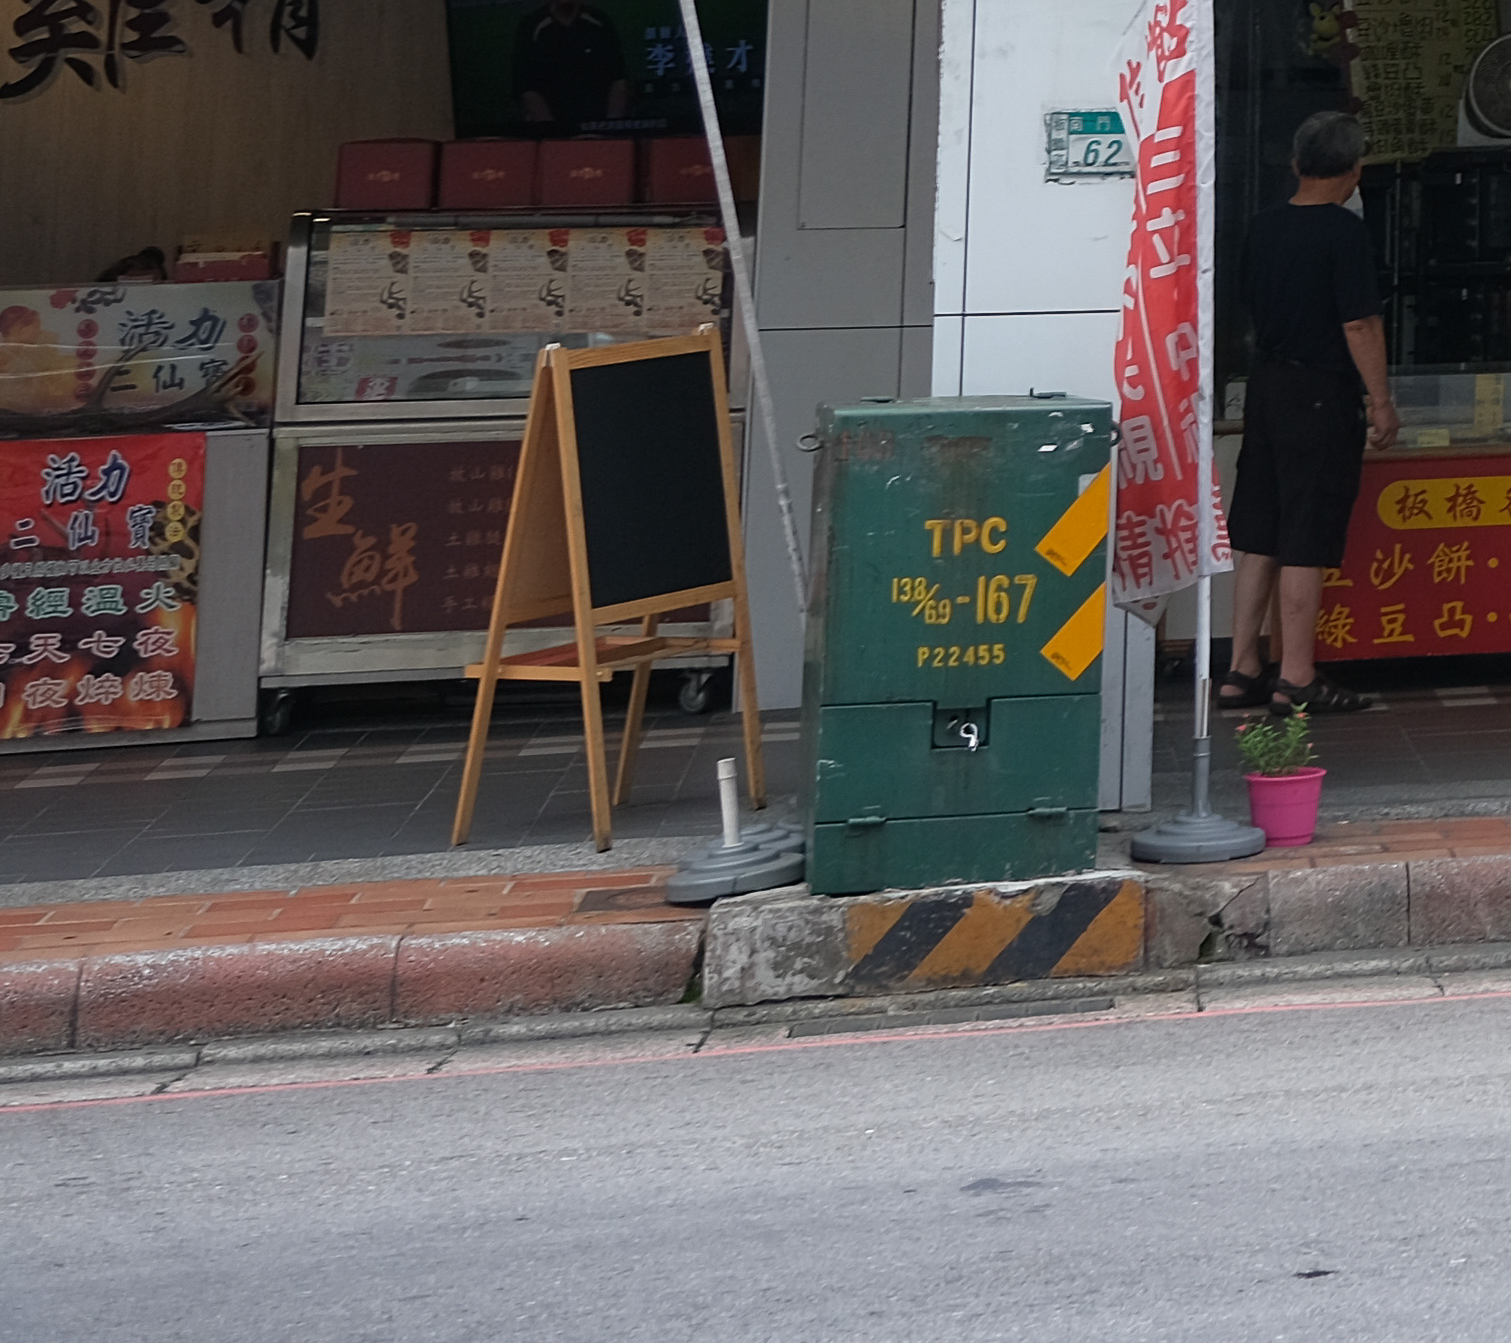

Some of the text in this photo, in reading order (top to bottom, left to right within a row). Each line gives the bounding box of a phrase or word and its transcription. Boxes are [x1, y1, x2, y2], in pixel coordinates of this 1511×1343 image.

[1084, 140, 1123, 166] 62
[118, 307, 227, 351] 活力
[41, 450, 131, 504] 活力
[10, 504, 160, 550] 二仙寶
[925, 516, 1007, 557] TPC
[917, 644, 1005, 668] P22455
